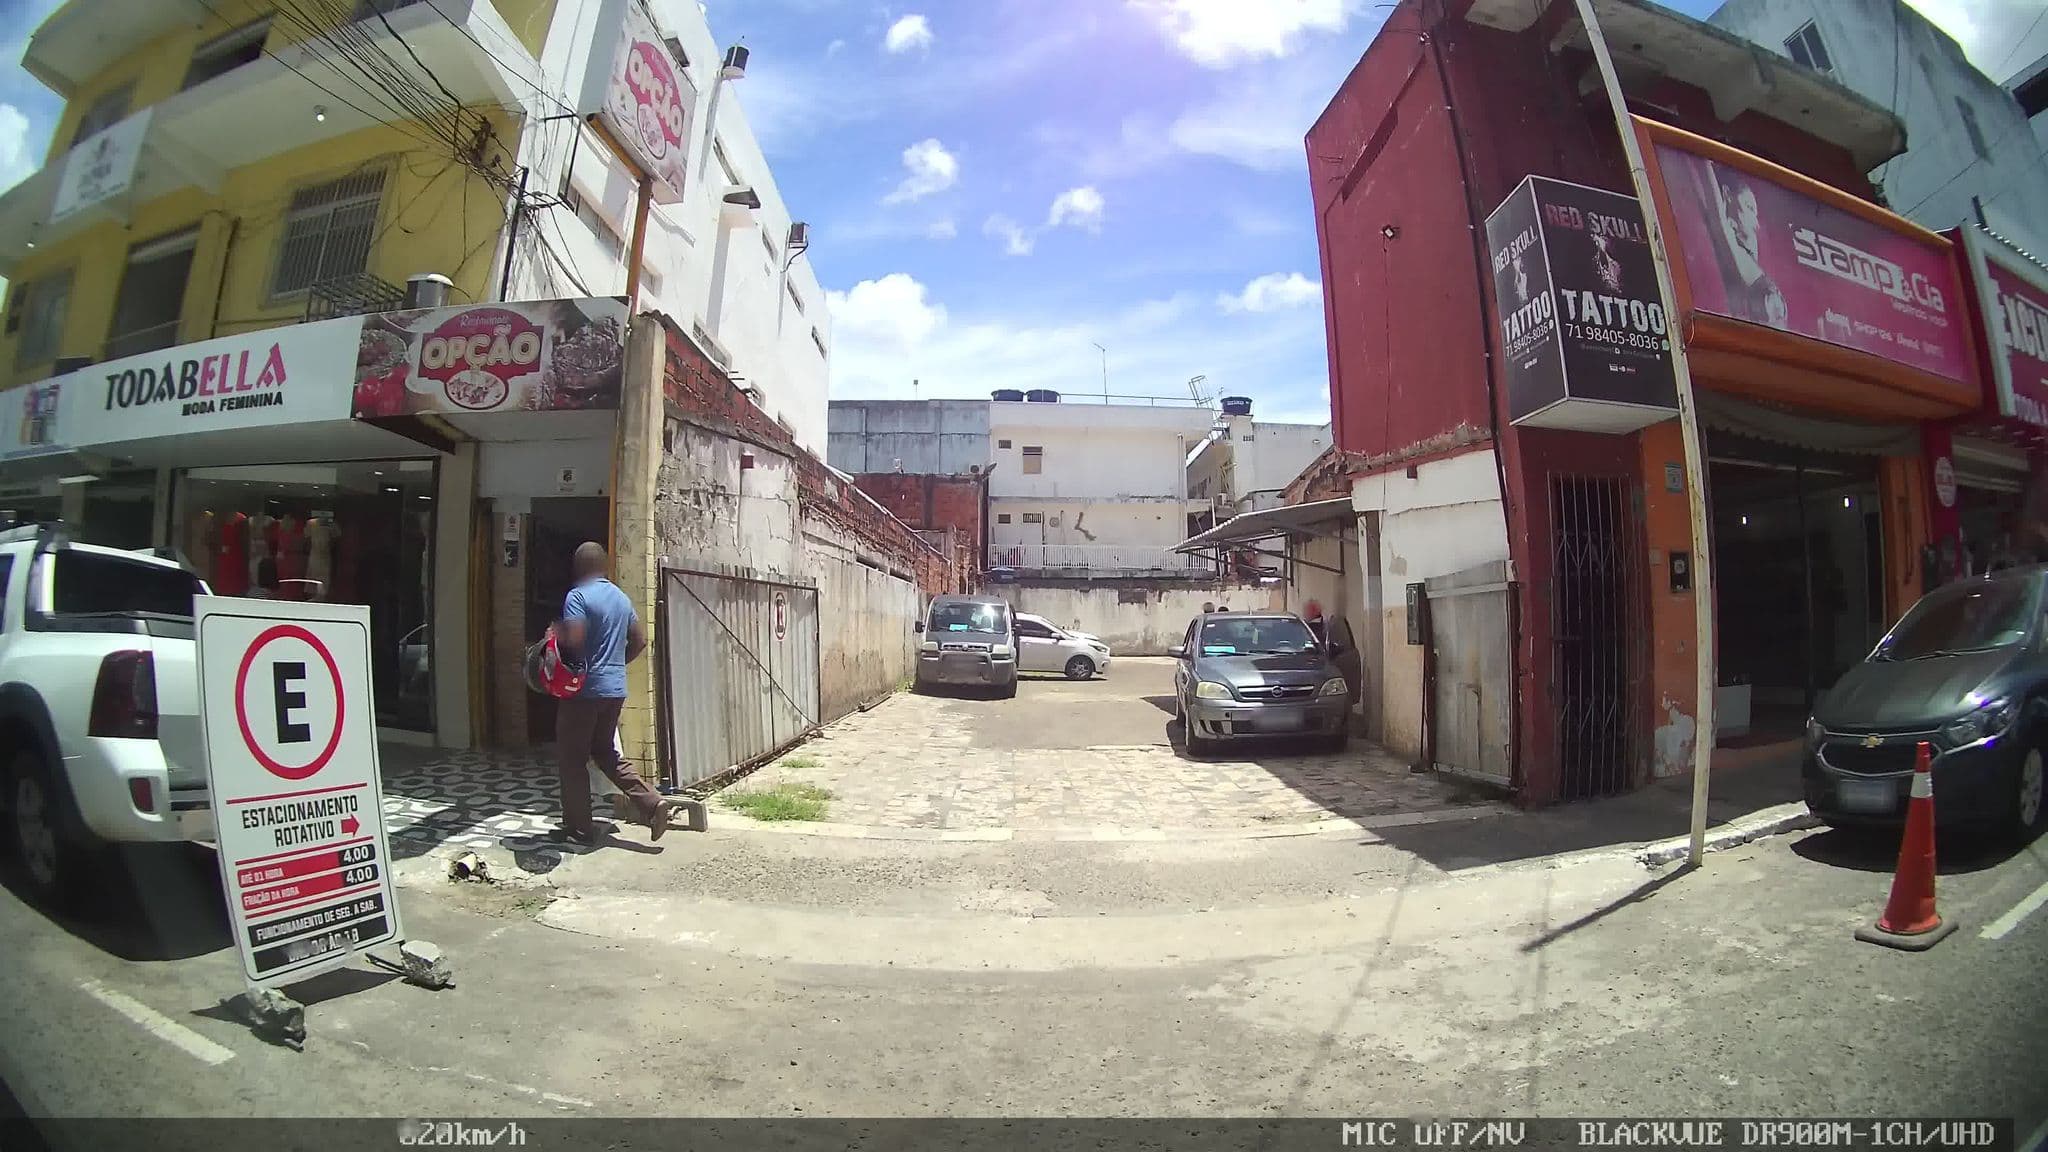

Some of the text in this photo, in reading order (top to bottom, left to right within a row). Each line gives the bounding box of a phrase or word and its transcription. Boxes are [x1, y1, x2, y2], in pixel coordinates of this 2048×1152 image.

[1545, 203, 1647, 245] RED SKULL
[1495, 225, 1538, 274] RED SKULL
[1503, 290, 1552, 343] TATTOO
[1561, 288, 1666, 335] TATTOO
[421, 324, 541, 374] OPÇÃO
[1565, 323, 1659, 350] 71 98405-8036
[105, 342, 287, 410] TODABELLA
[181, 391, 283, 416] MODA FEMININA
[273, 661, 311, 744] E
[241, 795, 358, 829] ESTACIONAMENTO
[274, 820, 335, 847] ROTATIVO
[256, 899, 378, 941] FUNCIONAMENTO DE SEG. A SAB.
